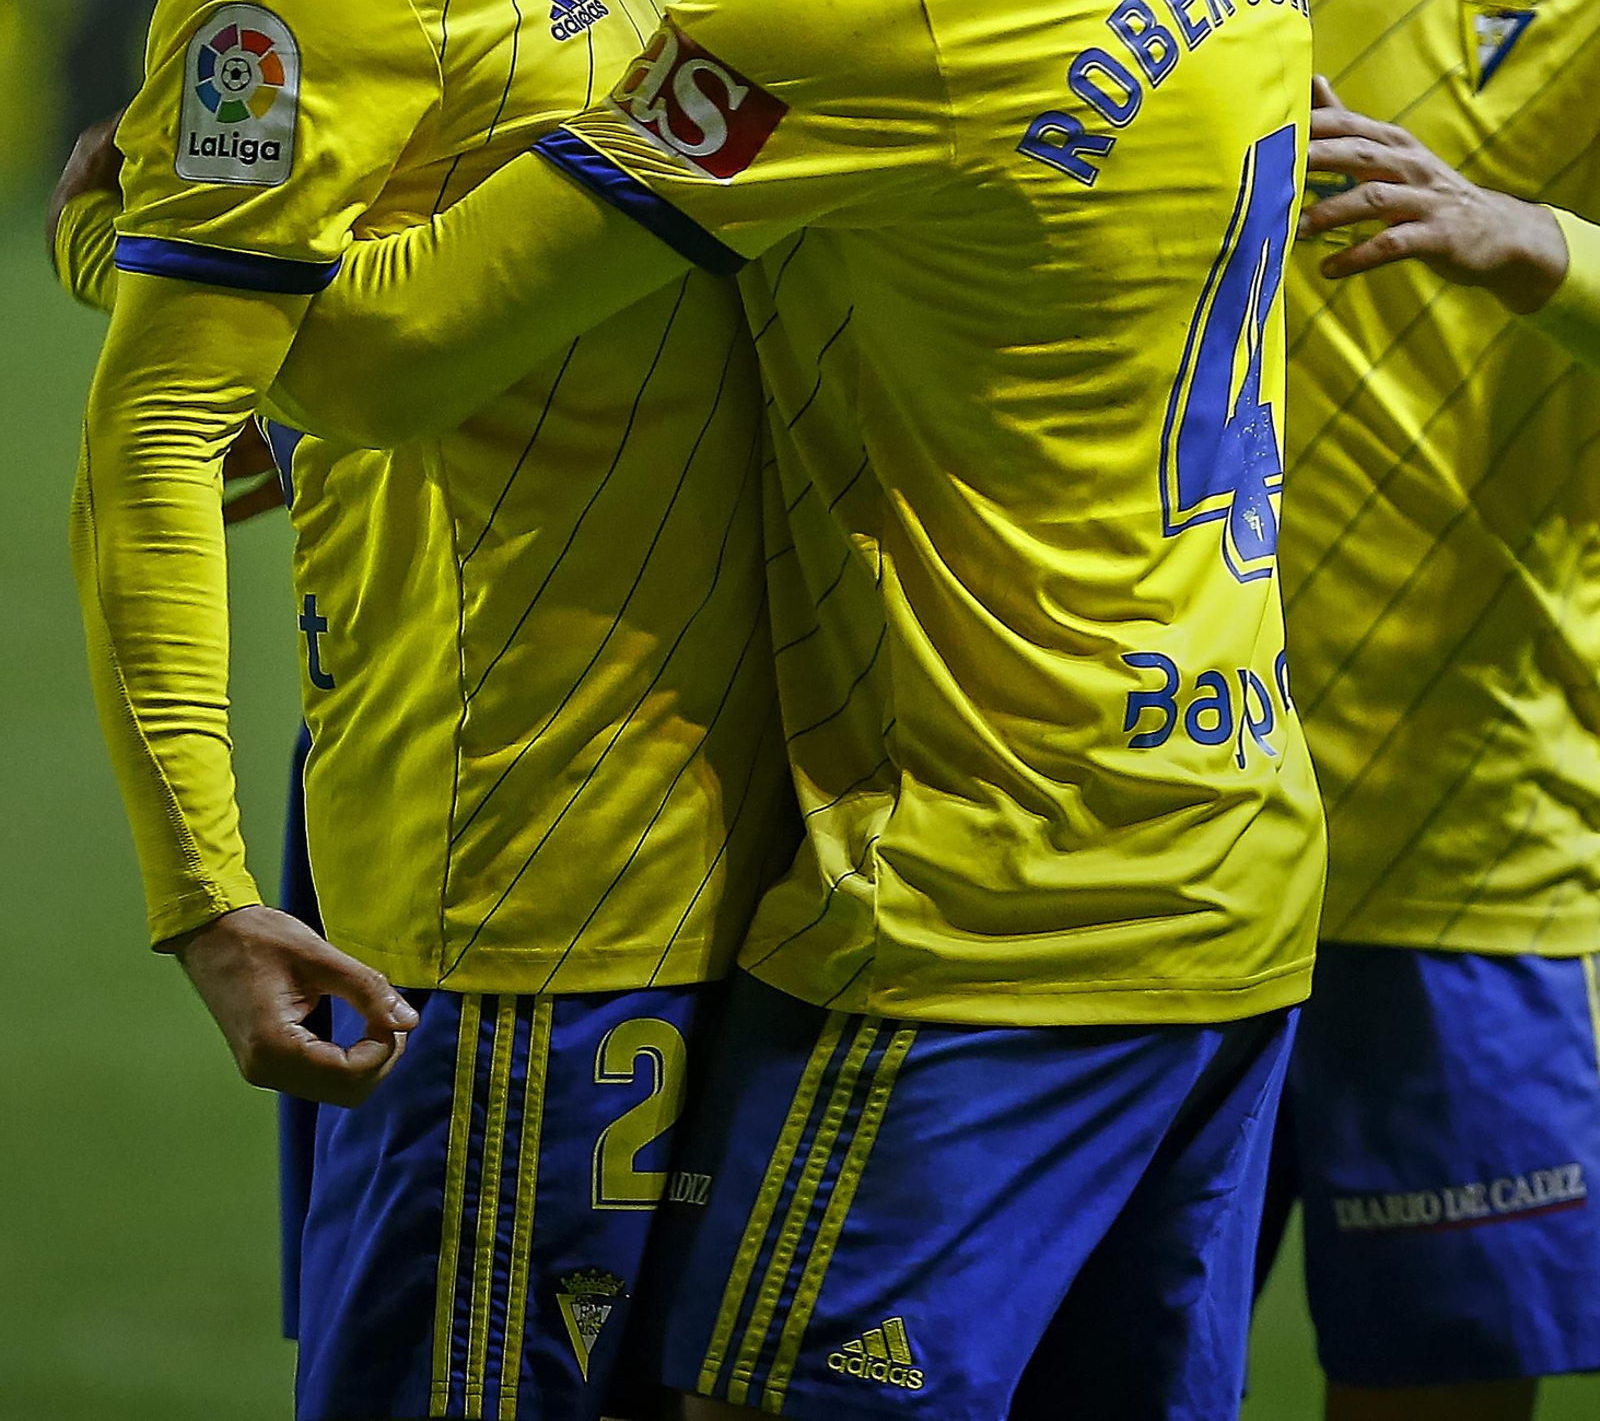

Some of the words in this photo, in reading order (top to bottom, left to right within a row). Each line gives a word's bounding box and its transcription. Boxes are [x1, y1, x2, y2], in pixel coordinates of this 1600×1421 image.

[612, 27, 749, 156] as
[188, 131, 281, 166] LaLiga
[1158, 123, 1296, 584] 4
[591, 1017, 687, 1210] 2
[1334, 1190, 1442, 1231] DIARIO
[1443, 1183, 1491, 1221] DE
[828, 1352, 924, 1390] adidas
